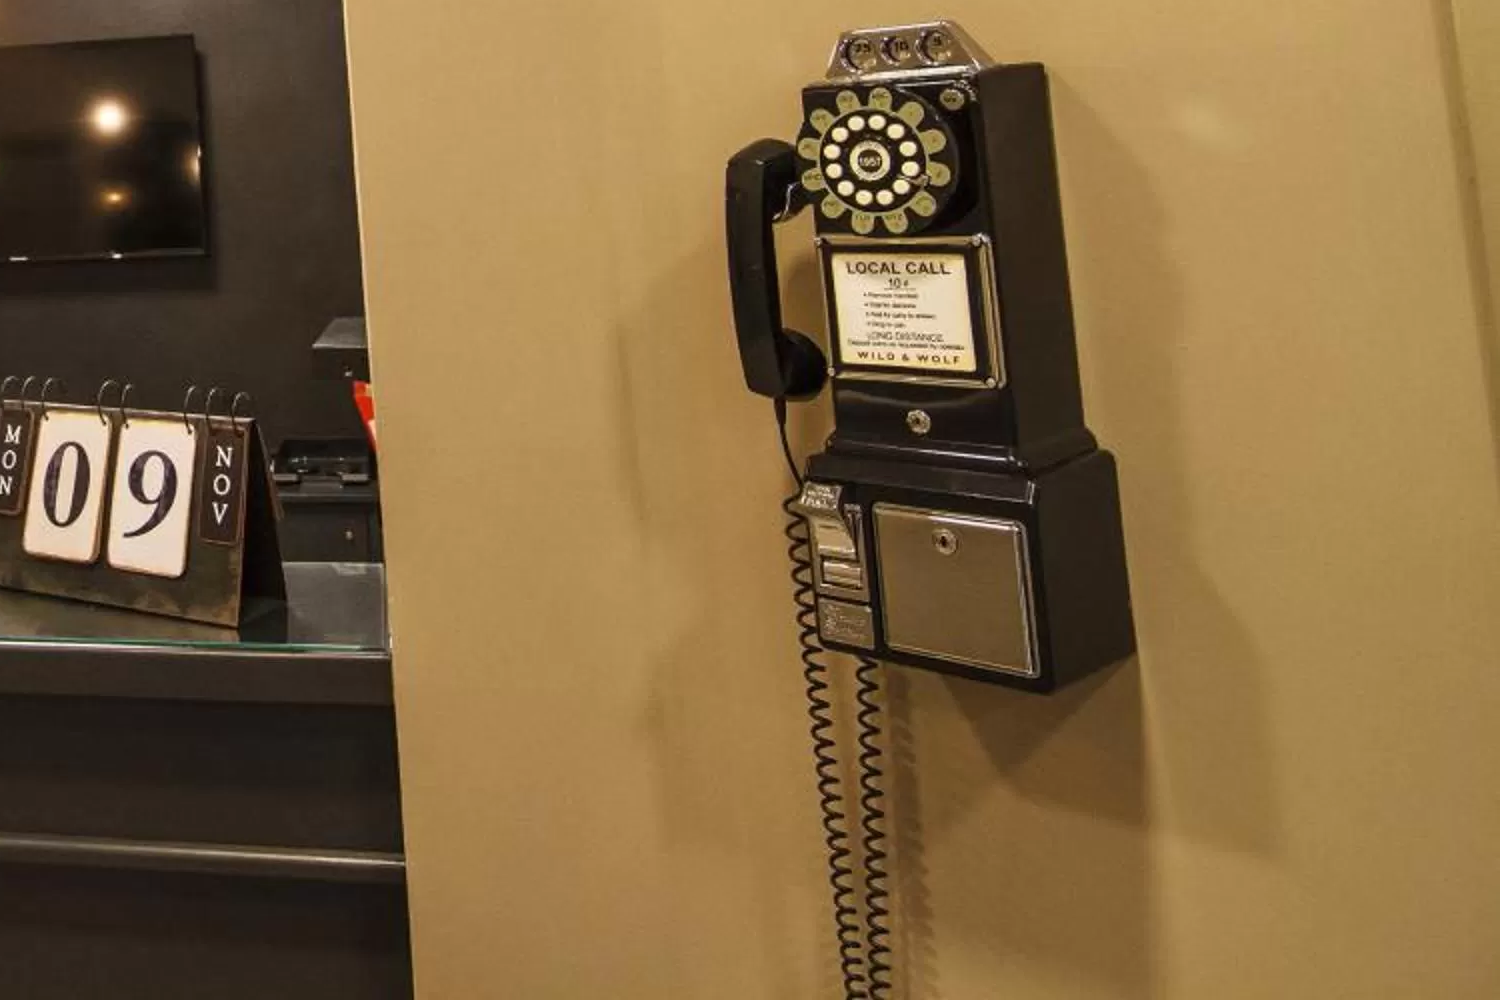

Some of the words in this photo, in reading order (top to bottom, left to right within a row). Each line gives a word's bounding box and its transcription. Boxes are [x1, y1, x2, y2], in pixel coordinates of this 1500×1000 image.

[846, 261, 901, 275] LOCAL
[905, 261, 952, 275] CALL
[857, 351, 895, 361] WILD
[917, 354, 961, 364] WOLF
[212, 445, 233, 526] NOV
